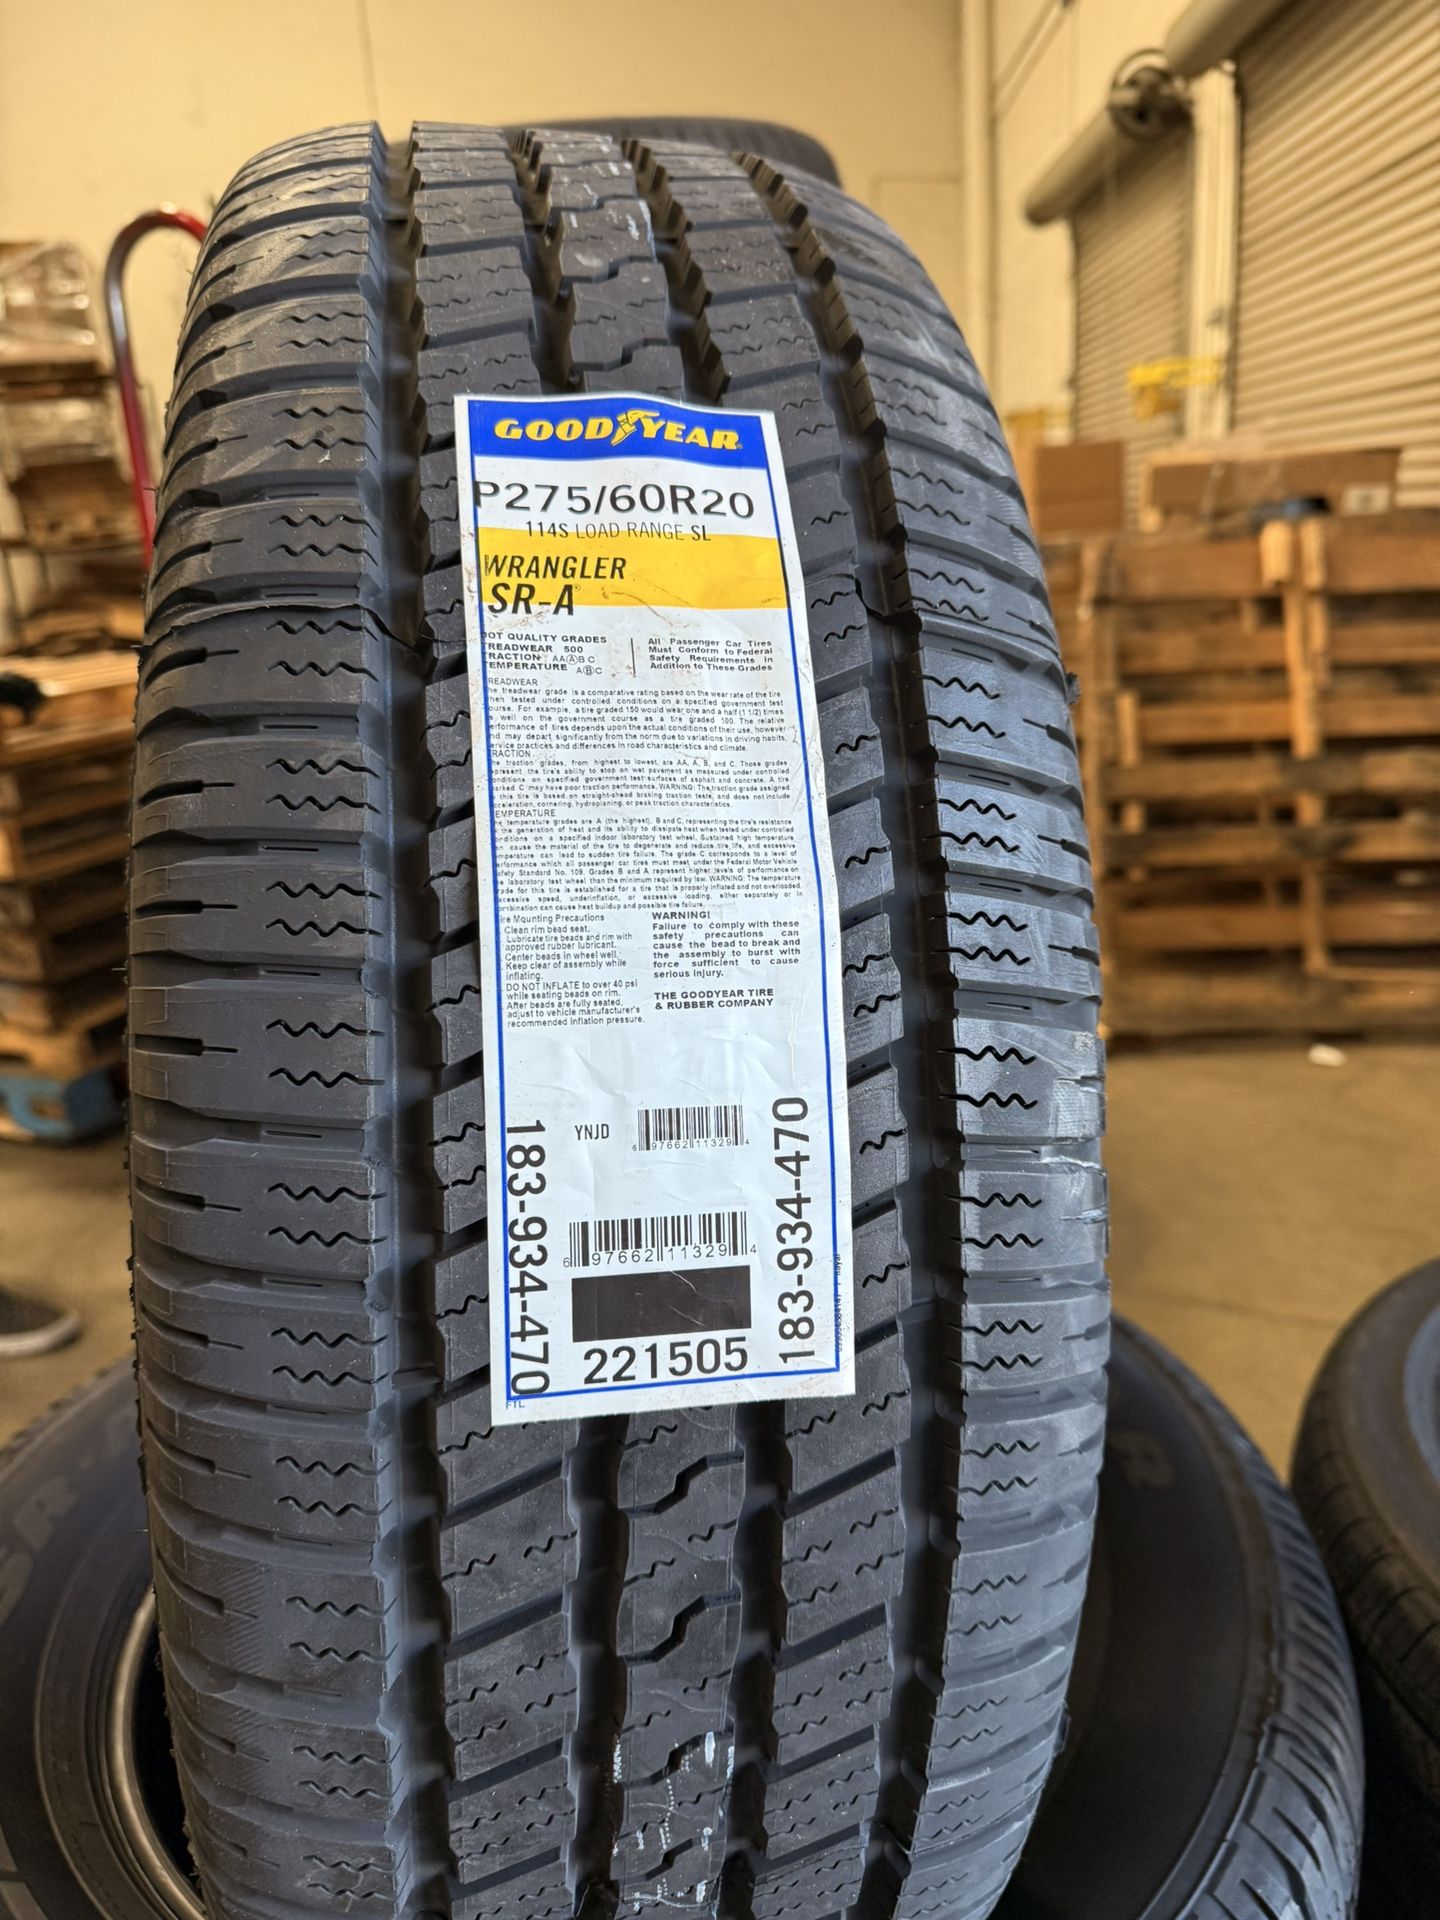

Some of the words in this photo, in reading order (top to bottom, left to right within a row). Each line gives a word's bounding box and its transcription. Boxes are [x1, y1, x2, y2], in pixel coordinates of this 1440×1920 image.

[494, 410, 740, 450] GOODYEAR
[474, 480, 754, 518] P275/60R20
[526, 521, 569, 537] 114S
[576, 523, 620, 538] LOAD
[628, 523, 683, 540] RANGE
[691, 525, 711, 541] SL
[485, 555, 627, 580] WRANGLER
[488, 582, 575, 615] SR-A
[508, 633, 557, 642] QUALITY
[562, 635, 607, 643] GRADES
[670, 638, 719, 647] Passenger
[689, 656, 755, 664] Requirements
[517, 742, 552, 751] practices
[556, 914, 604, 922] Precautions
[652, 911, 710, 920] WARNING!
[504, 926, 528, 934] Clean
[570, 925, 590, 933] seat.
[709, 921, 745, 931] comply
[748, 920, 769, 928] with
[507, 935, 543, 943] Lubricate
[653, 932, 684, 941] safety
[705, 930, 764, 940] precautions
[505, 943, 545, 953] approved
[548, 942, 575, 950] rubber
[578, 941, 617, 949] lubricant.
[711, 940, 736, 948] bead
[752, 939, 780, 947] break
[505, 953, 533, 961] Center
[536, 952, 561, 960] beads
[573, 951, 598, 959] wheel
[679, 950, 726, 959] assembly
[506, 961, 527, 970] Keep
[530, 961, 551, 969] clear
[553, 961, 562, 969] of
[564, 960, 603, 969] assembly
[606, 959, 626, 967] while
[653, 961, 679, 969] force
[692, 959, 739, 967] sufficient
[506, 972, 543, 981] inflating.
[654, 970, 690, 978] serious
[693, 969, 724, 978] injury.
[506, 983, 519, 991] DO
[522, 983, 540, 991] NOT
[543, 981, 580, 990] INFLATE
[625, 979, 637, 988] psi
[532, 991, 562, 1000] seating
[565, 990, 589, 998] beads
[655, 992, 677, 1000] THE
[681, 990, 744, 999] GOODYEAR
[507, 1001, 526, 1009] After
[530, 1000, 555, 1008] beads
[573, 999, 591, 1008] fully
[655, 1002, 663, 1010] &
[667, 1001, 715, 1009] RUBBER
[718, 998, 774, 1008] COMPANY
[508, 1010, 533, 1019] adjust
[547, 1008, 576, 1016] vehicle
[579, 1006, 640, 1015] manufacturer's
[508, 1018, 567, 1028] recommended
[570, 1017, 604, 1025] inflation
[606, 1016, 644, 1025] pressure.
[574, 1123, 610, 1141] YNJD
[772, 1097, 816, 1364] 183-934-470
[506, 1119, 550, 1394] 183-934-470
[583, 1336, 749, 1385] 221505
